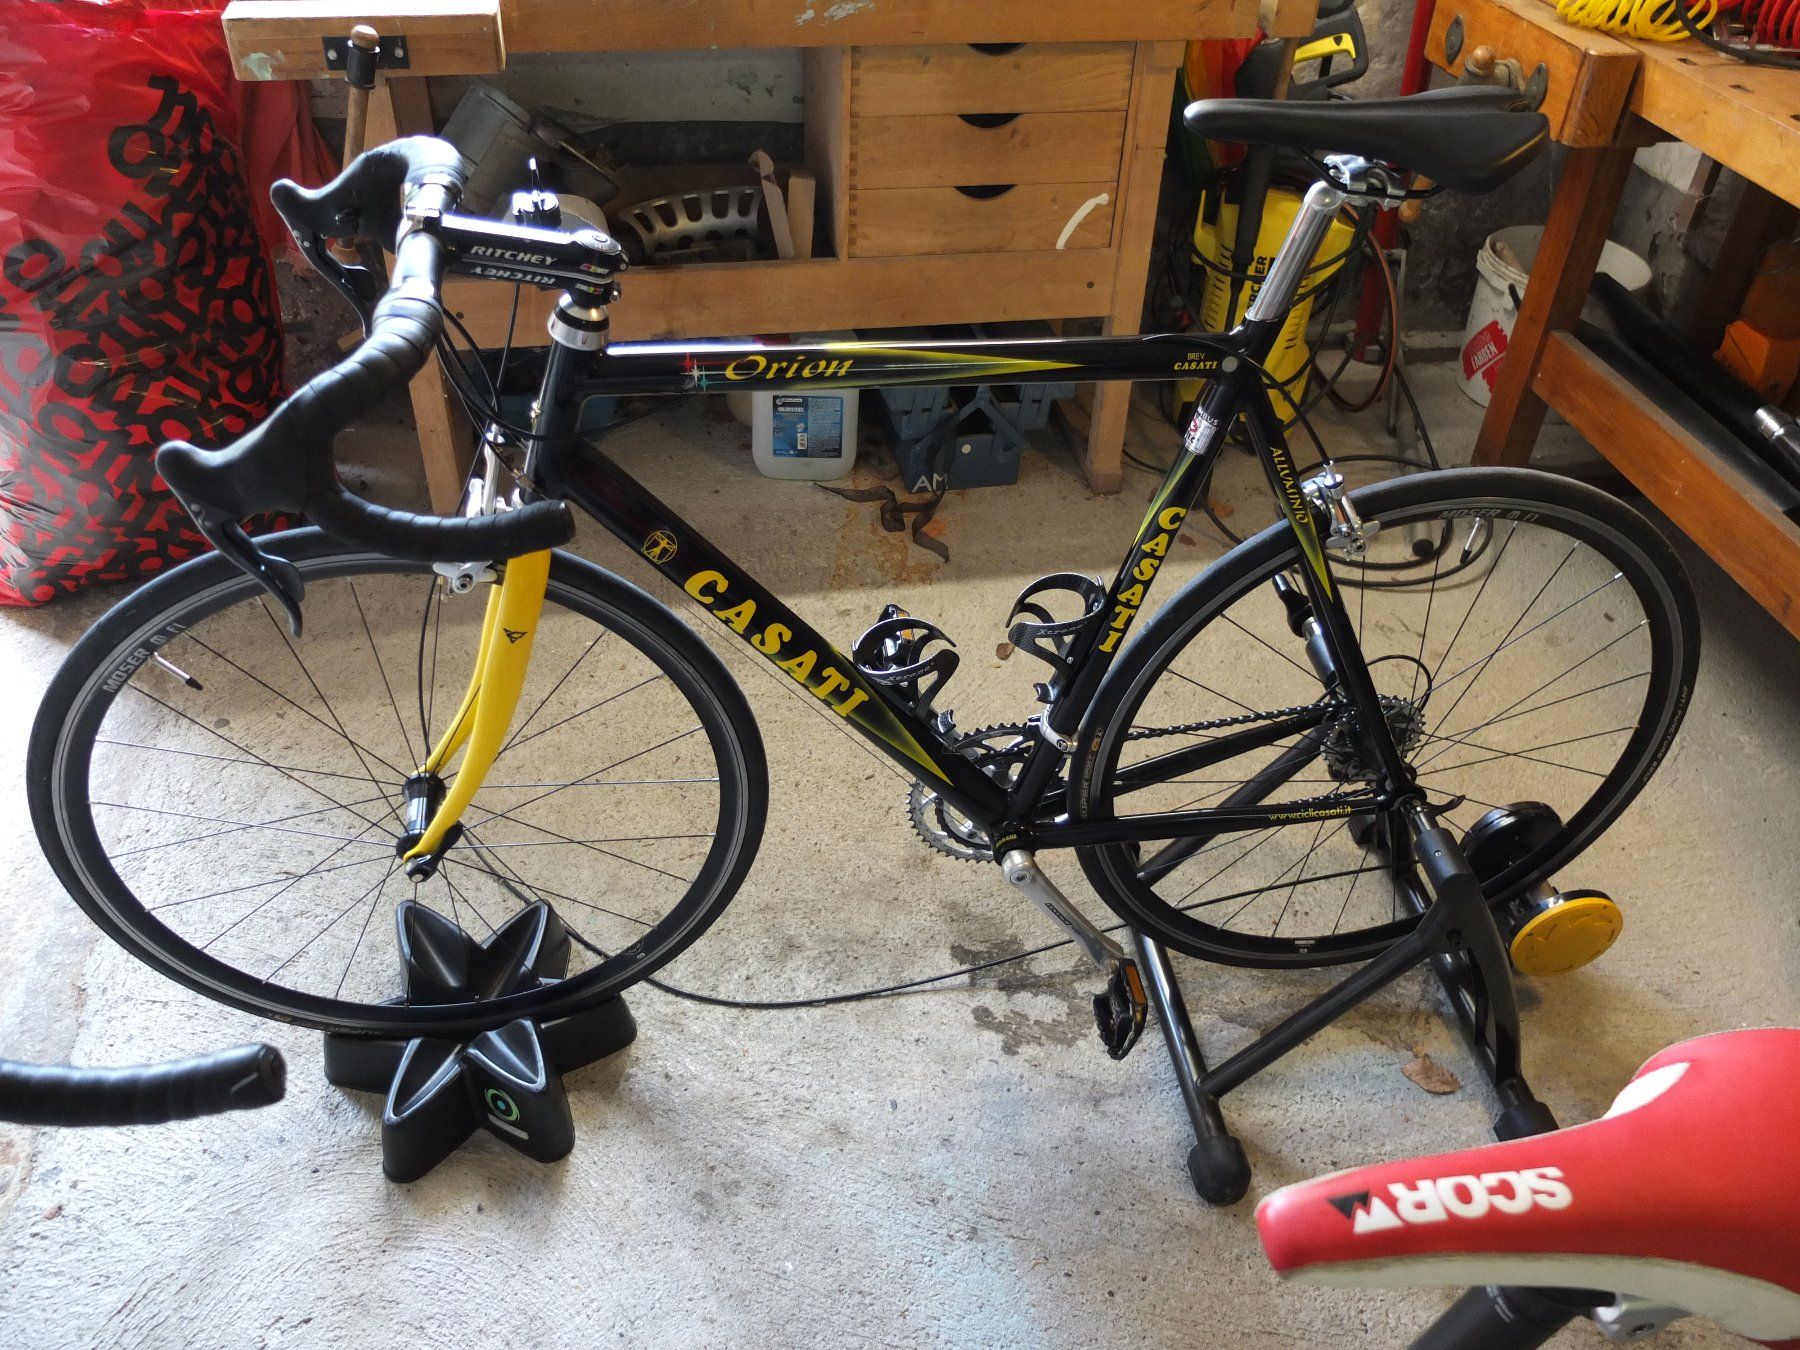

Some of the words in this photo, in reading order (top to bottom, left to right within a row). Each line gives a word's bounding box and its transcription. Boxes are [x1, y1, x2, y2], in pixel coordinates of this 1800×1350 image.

[470, 245, 558, 265] RITCHEY
[471, 266, 557, 284] RITCHEY
[725, 354, 854, 381] Orion
[1173, 361, 1218, 371] CASATI
[1098, 506, 1187, 653] CASATI
[684, 569, 870, 718] CASATI
[102, 647, 151, 693] MOSER
[1268, 805, 1352, 821] www.ciclicasati.it
[1387, 1166, 1573, 1226] SCOR
